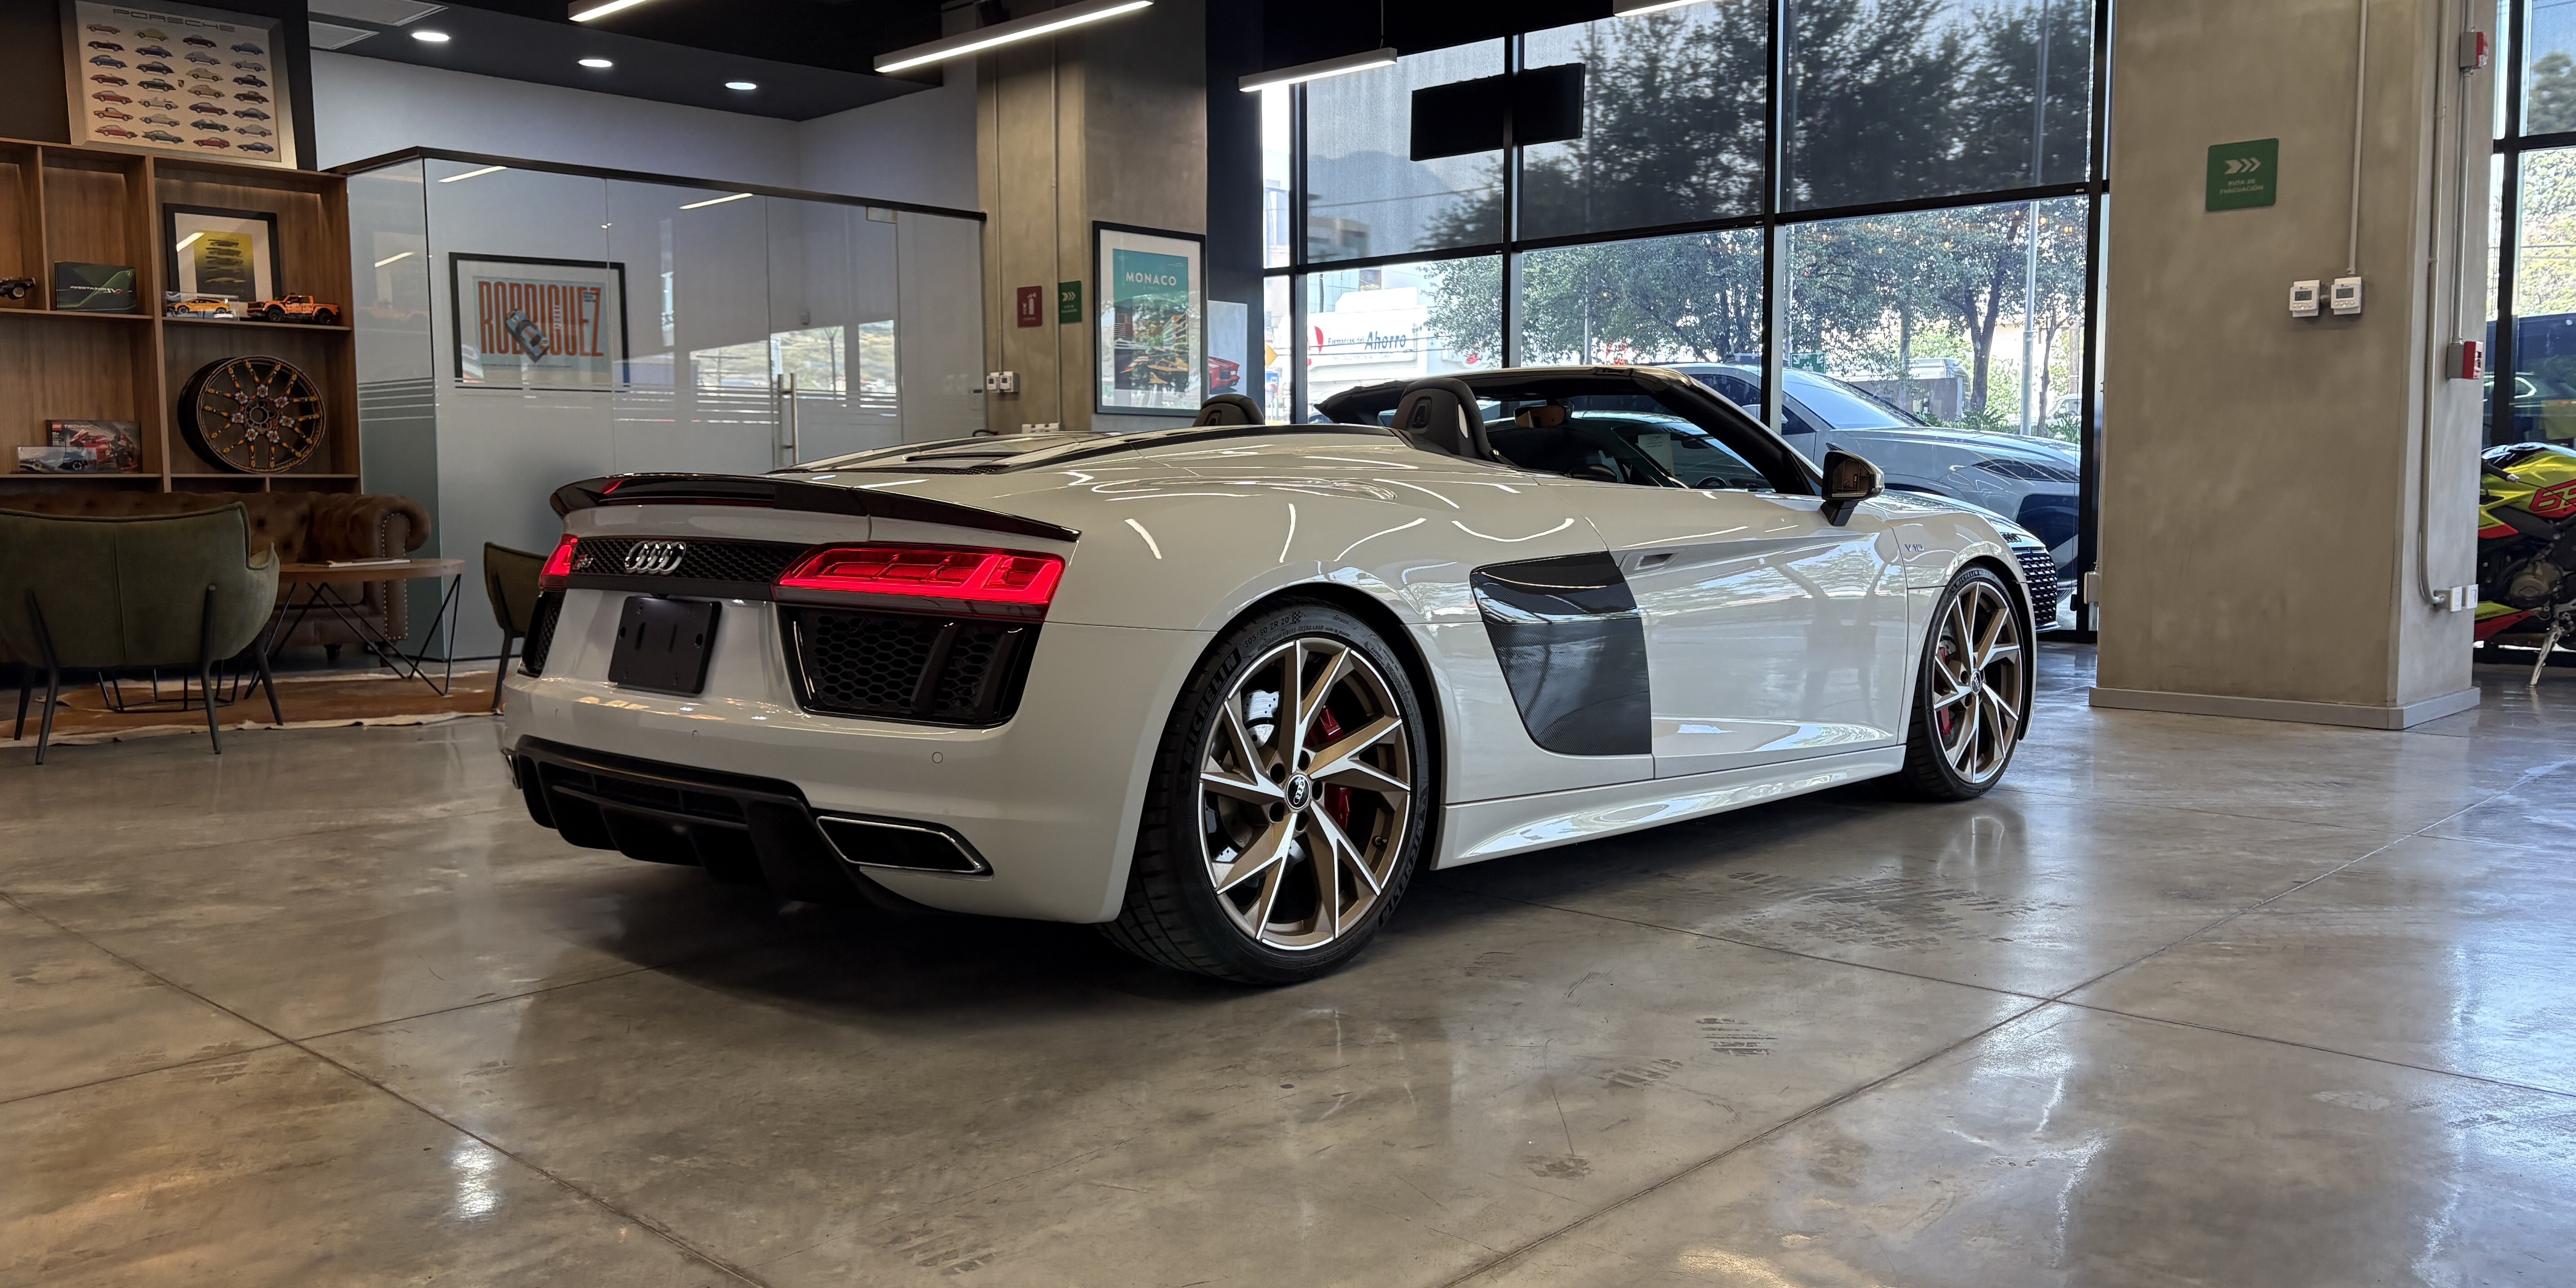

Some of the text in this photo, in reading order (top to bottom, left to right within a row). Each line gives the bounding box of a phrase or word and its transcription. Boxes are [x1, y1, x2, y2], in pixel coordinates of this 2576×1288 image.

[113, 9, 234, 32] PORSCHE
[1126, 271, 1176, 286] MONACO
[1365, 331, 1406, 350] Ahorro
[1244, 627, 1268, 648] 305/30
[1270, 621, 1278, 630] ZR
[1281, 617, 1289, 626] 20
[1182, 652, 1237, 766] MICHELIN
